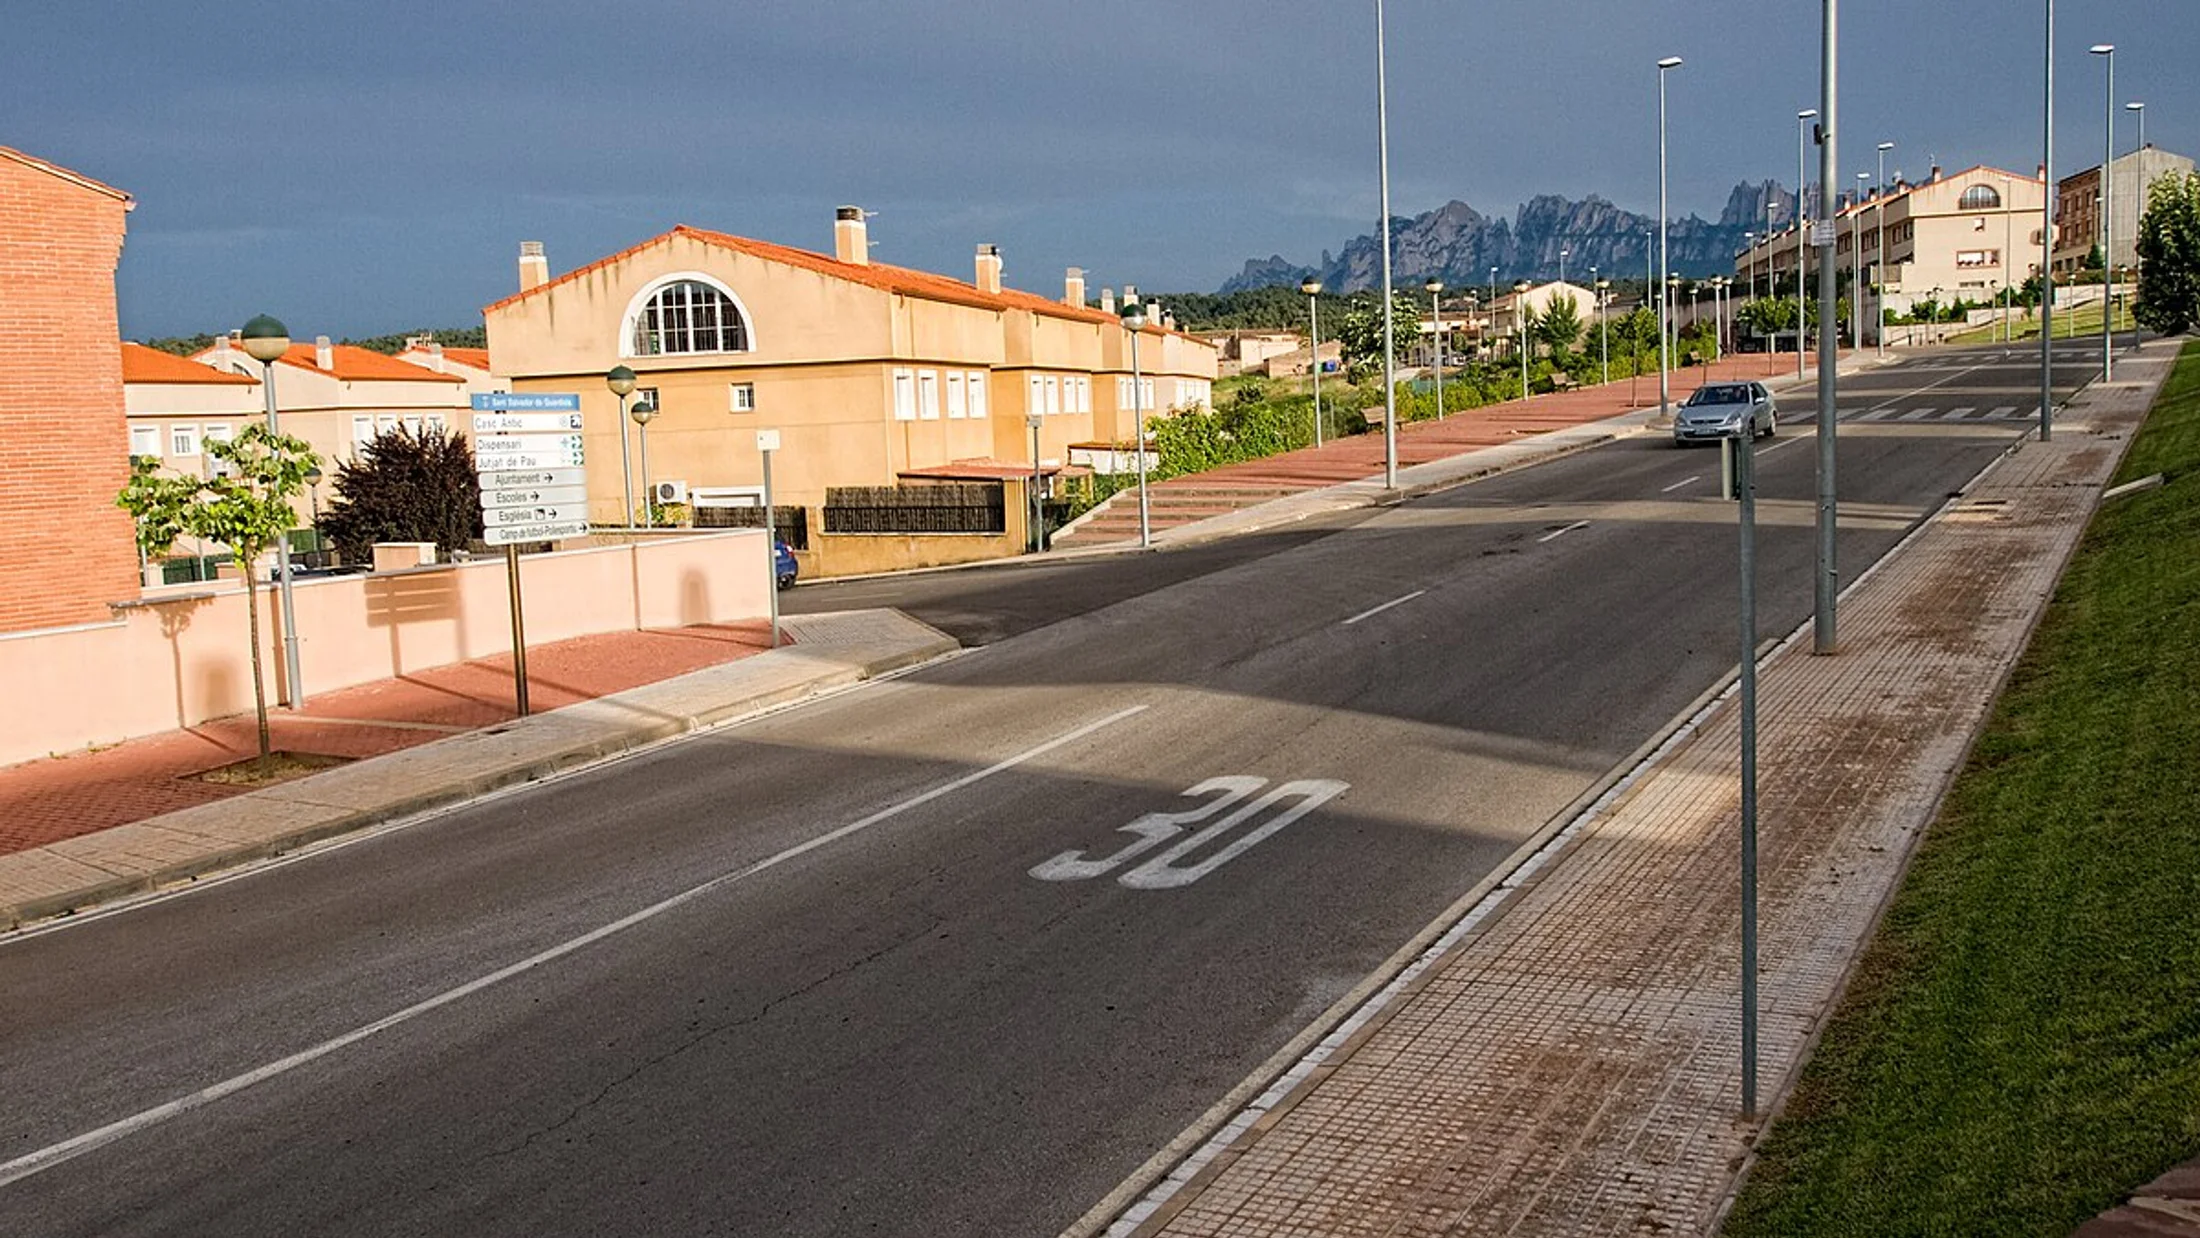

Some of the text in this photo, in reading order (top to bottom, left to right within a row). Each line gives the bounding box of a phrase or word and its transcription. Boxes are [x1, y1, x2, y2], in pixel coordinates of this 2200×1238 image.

[475, 417, 496, 429] Casc
[478, 439, 522, 450] Dispensari
[506, 457, 517, 467] de
[520, 456, 536, 467] Pau
[495, 473, 540, 486] Ajuntament
[496, 492, 527, 503] Escoles
[1027, 775, 1350, 889] 30
